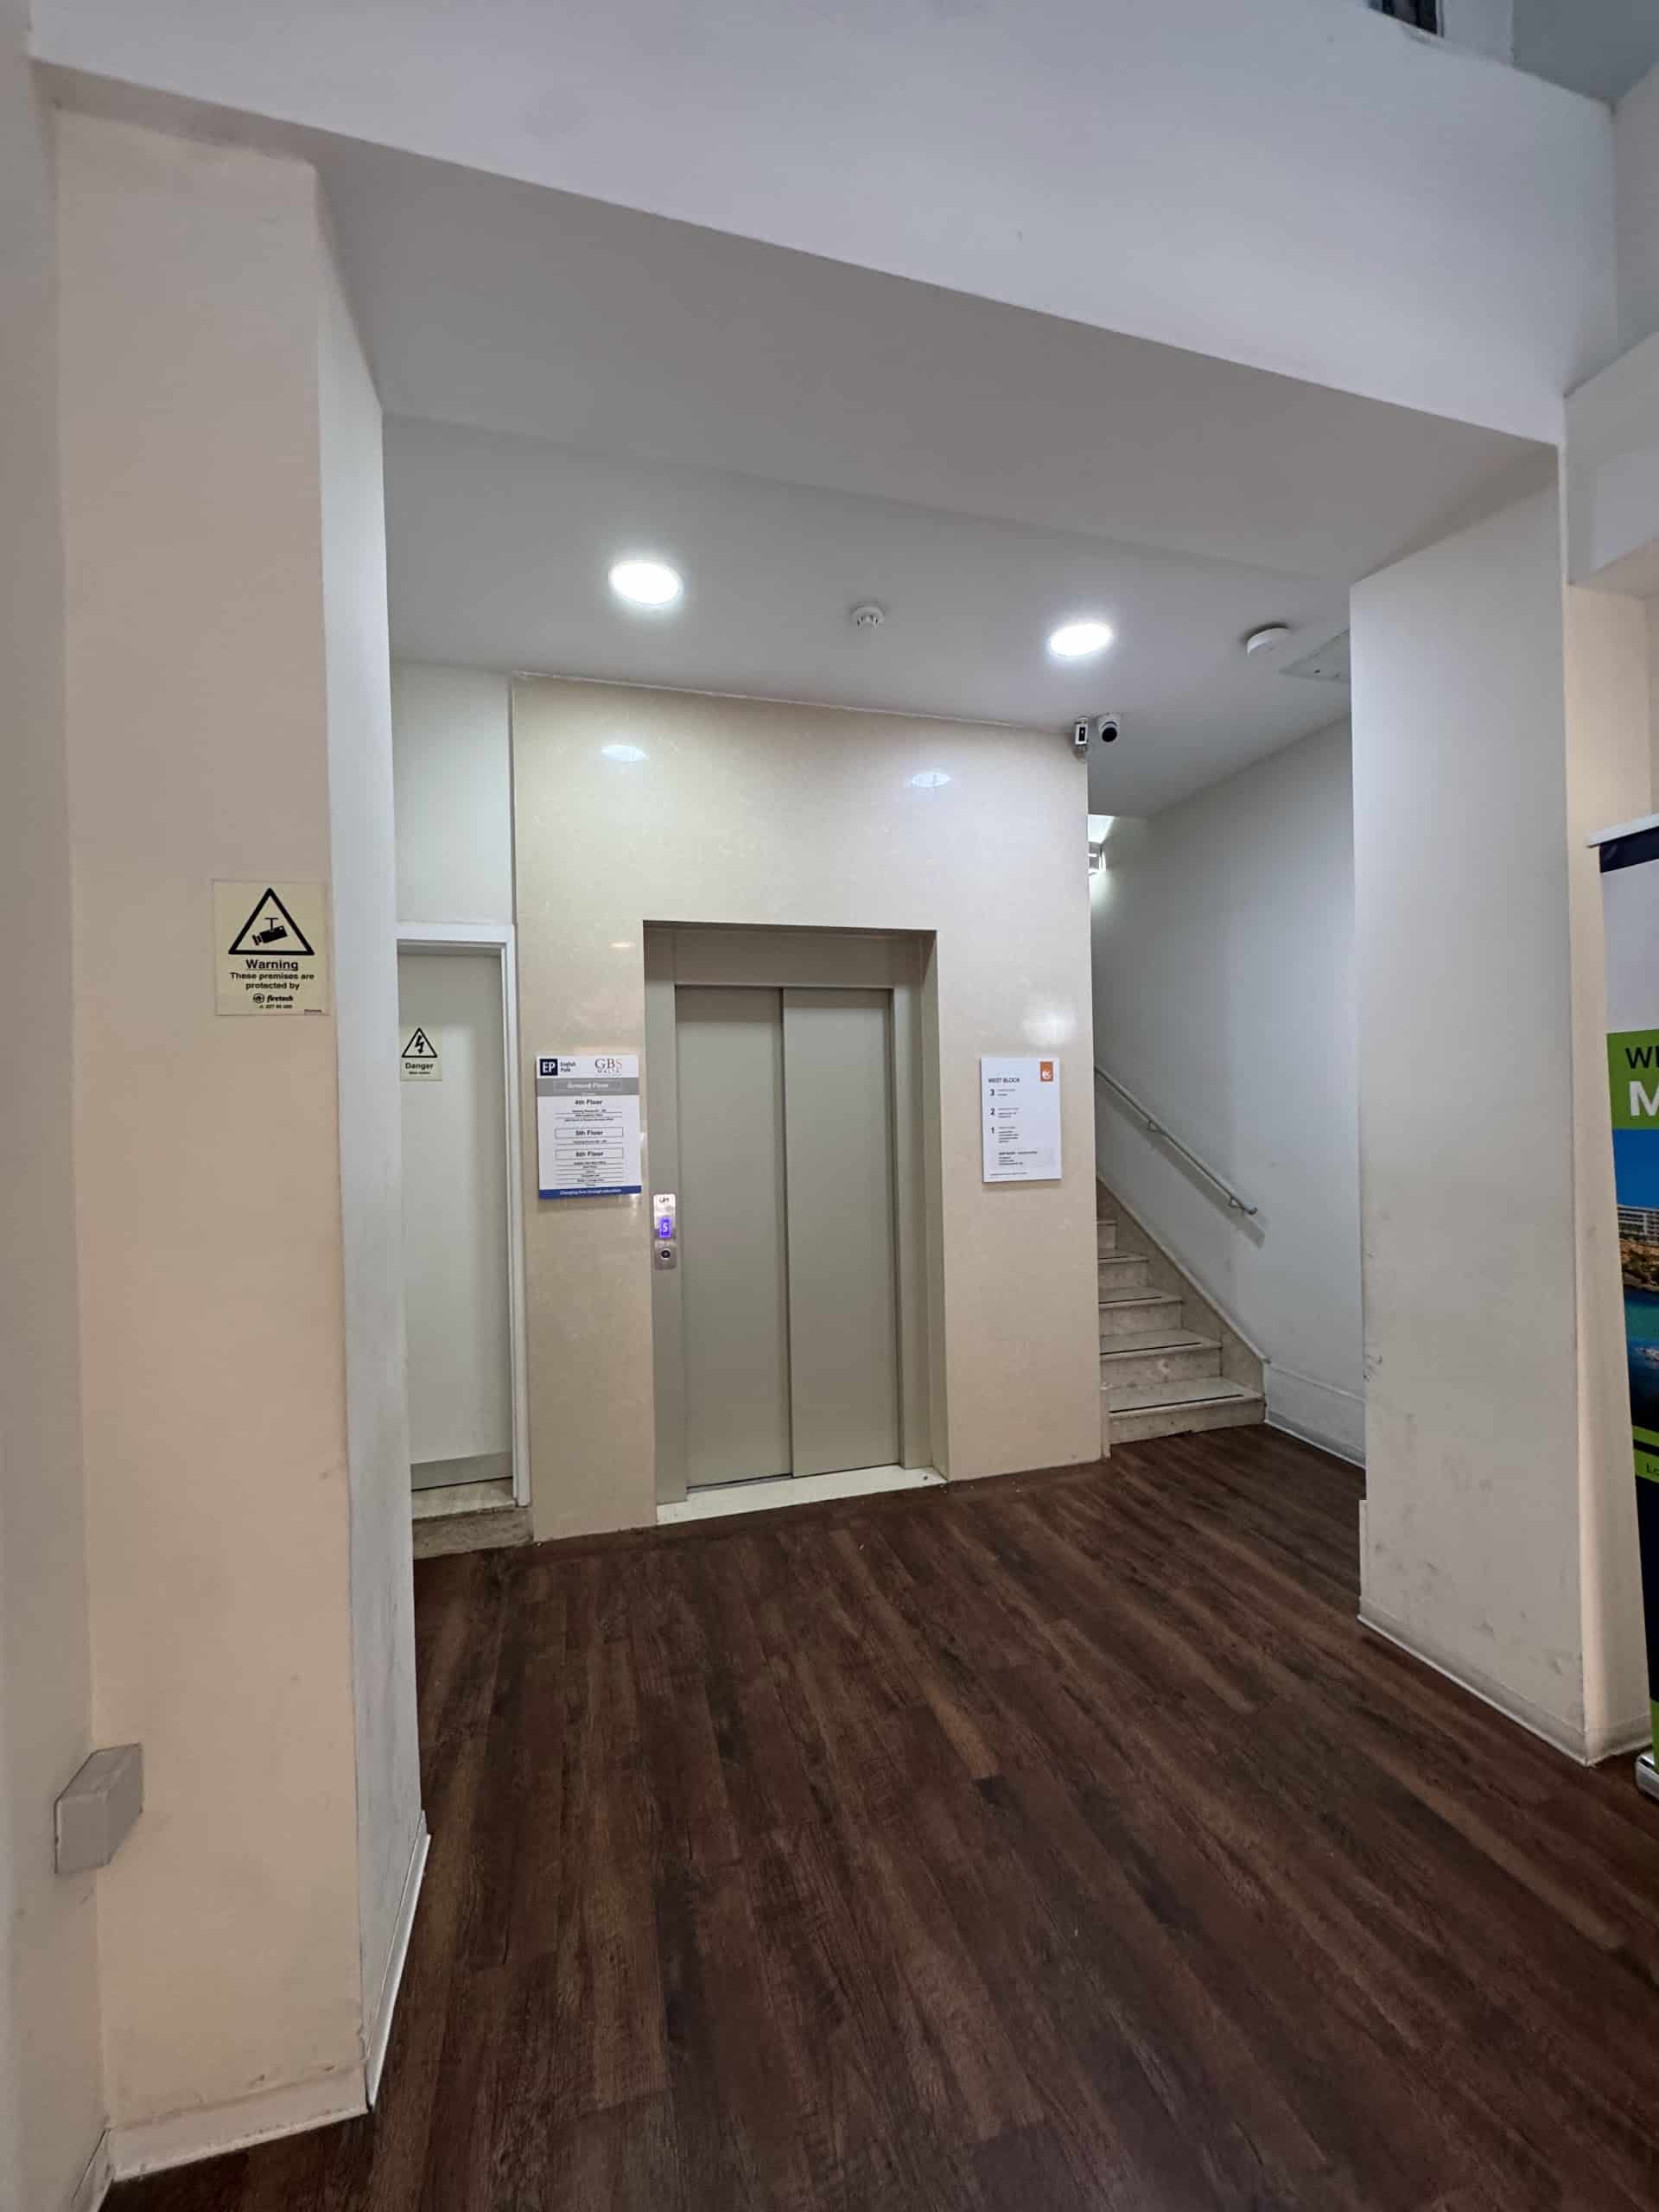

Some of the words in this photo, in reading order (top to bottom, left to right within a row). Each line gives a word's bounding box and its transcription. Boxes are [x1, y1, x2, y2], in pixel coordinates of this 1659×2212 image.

[245, 959, 299, 972] Warning
[245, 982, 288, 991] protected
[289, 982, 300, 991] by
[404, 1062, 434, 1071] Danger
[542, 1061, 556, 1073] EP
[594, 1058, 623, 1070] GBS
